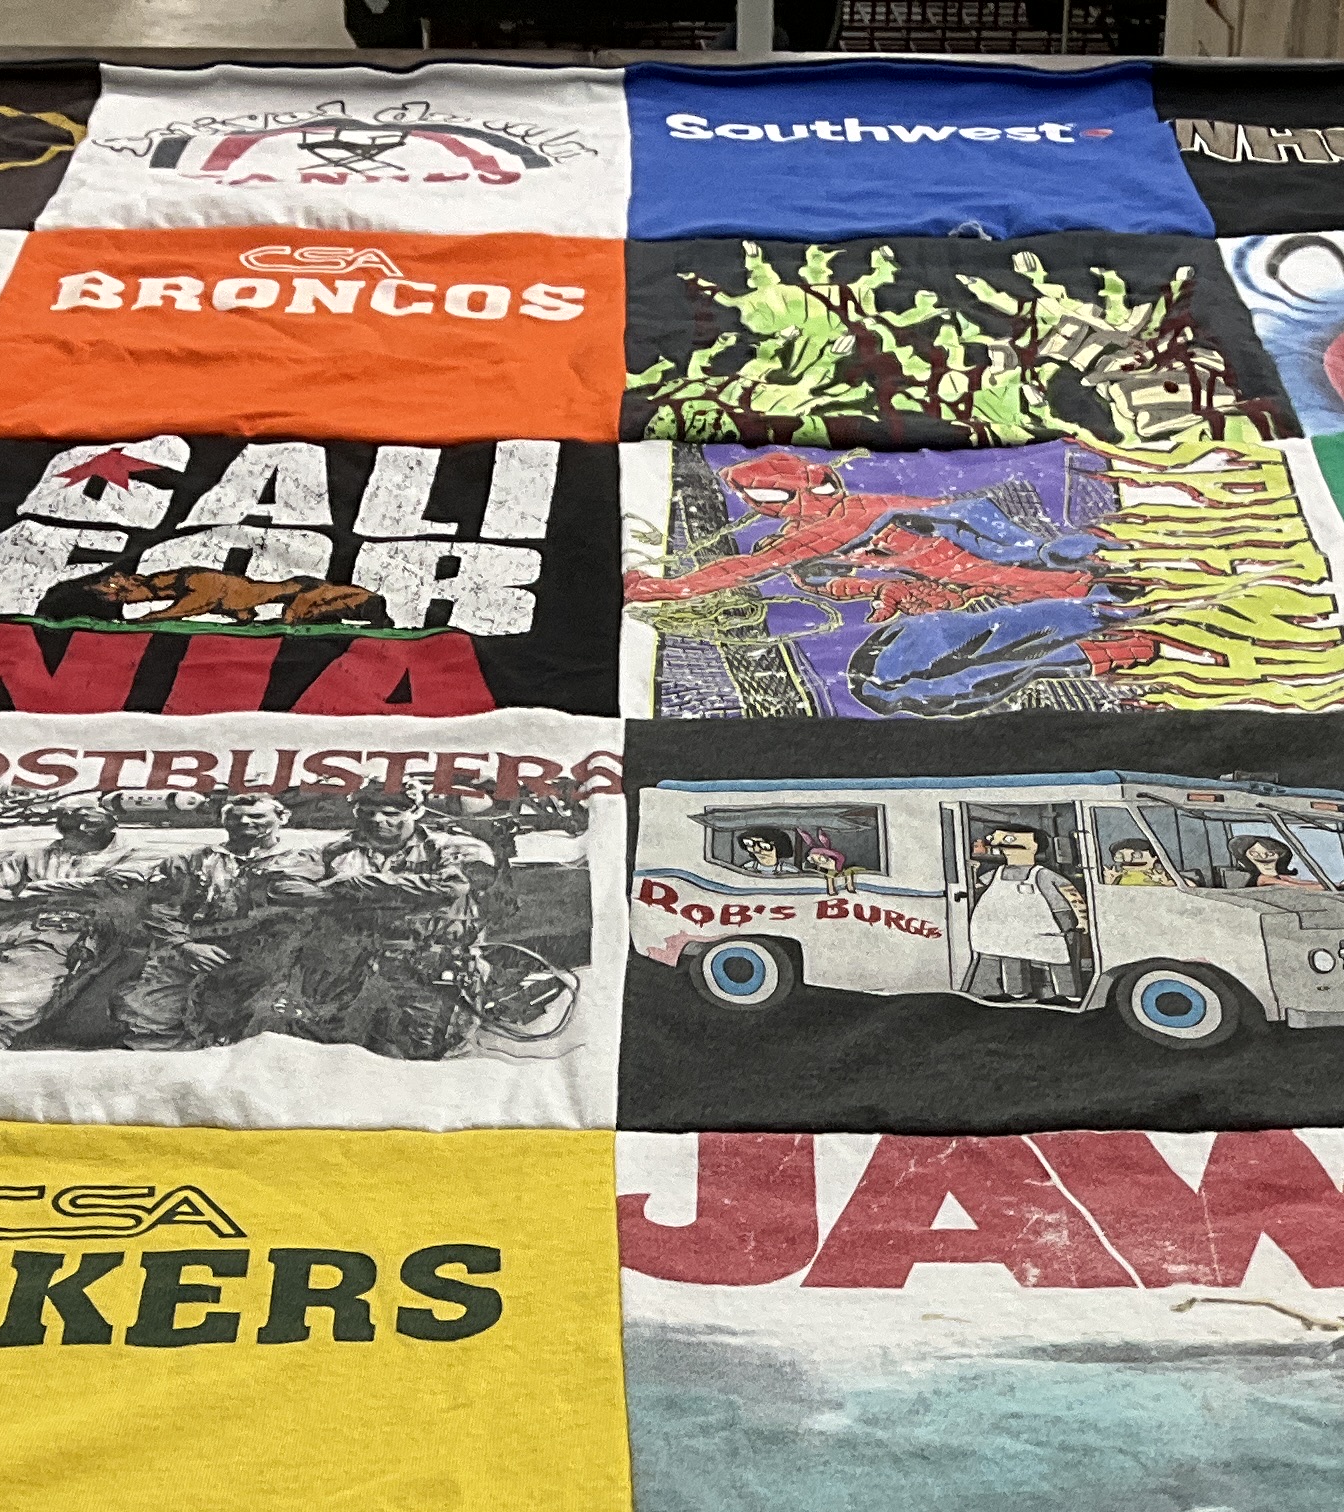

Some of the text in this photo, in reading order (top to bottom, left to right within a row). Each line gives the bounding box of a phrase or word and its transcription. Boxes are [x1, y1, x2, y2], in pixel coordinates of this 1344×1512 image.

[665, 112, 1076, 144] Southwest
[239, 245, 404, 278] CSA
[49, 268, 585, 322] BRONCOS
[15, 434, 561, 540] CALI
